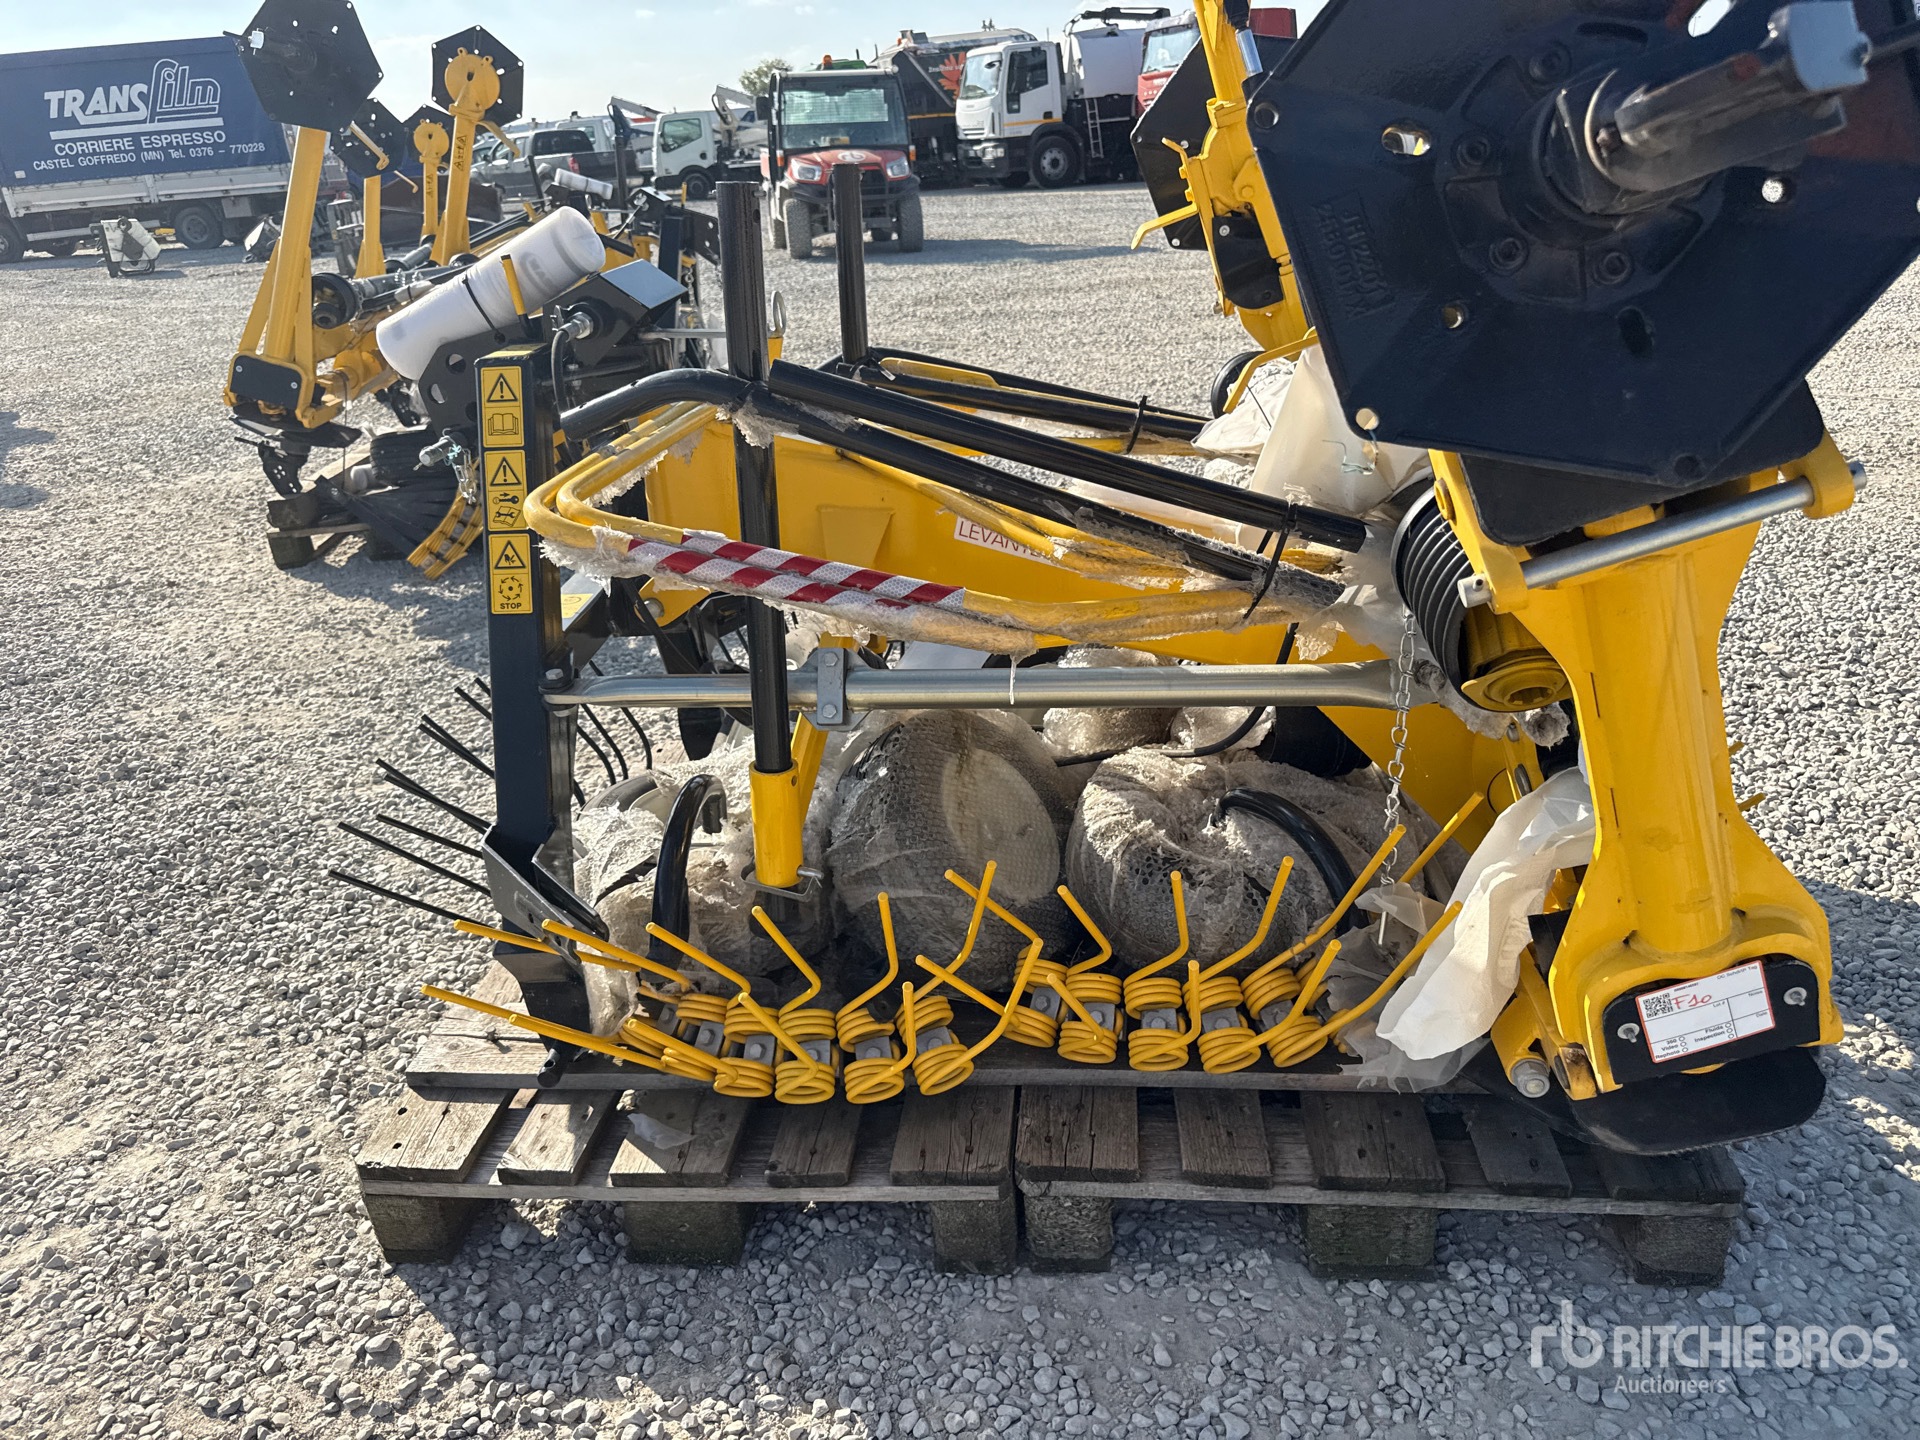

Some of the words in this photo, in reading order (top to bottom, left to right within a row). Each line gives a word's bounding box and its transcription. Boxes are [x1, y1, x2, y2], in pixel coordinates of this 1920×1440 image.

[54, 137, 135, 156] CORRIERE
[141, 130, 226, 149] ESPRESSO
[33, 157, 75, 171] CASTEL
[78, 152, 136, 167] GOFFREDO
[140, 149, 165, 163] (MN)
[170, 149, 186, 160] Tel.
[189, 146, 214, 158] 0376
[229, 142, 266, 155] 770228
[959, 520, 1041, 558] LEVAN
[500, 602, 522, 610] STOP
[1694, 1030, 1726, 1043] Inspection
[1661, 1043, 1679, 1052] Video
